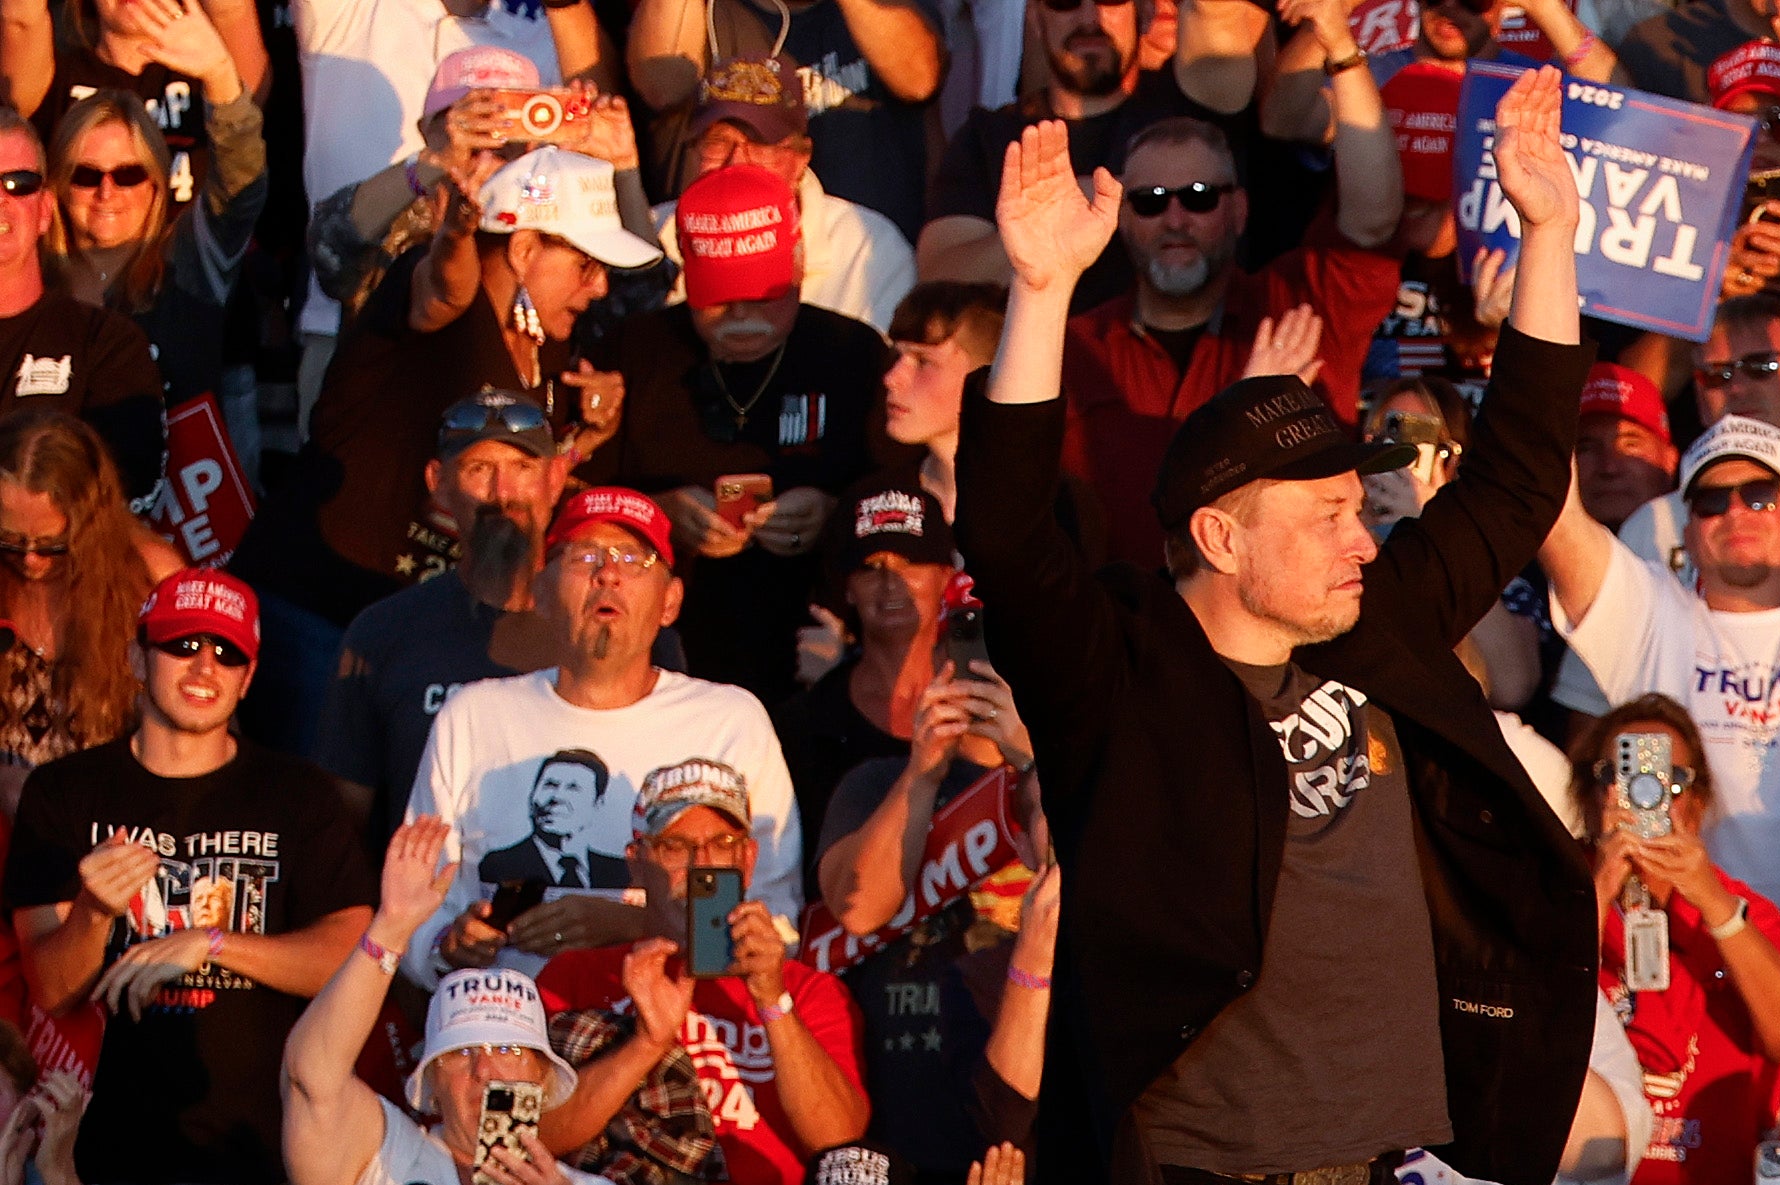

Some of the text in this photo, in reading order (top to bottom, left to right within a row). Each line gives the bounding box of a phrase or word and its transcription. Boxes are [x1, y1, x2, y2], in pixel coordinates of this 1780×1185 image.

[1566, 83, 1626, 110] 2024
[1580, 134, 1673, 174] AMERICA
[1674, 158, 1709, 183] MAKE
[684, 205, 783, 235] MAKE AMERICA
[735, 229, 778, 255] AGAIN
[1244, 389, 1303, 429] MAKE
[407, 521, 449, 553] TAKE
[90, 822, 279, 858] I WAS THERE
[446, 976, 537, 1002] TRUMP
[468, 994, 522, 1010] VANCE
[1452, 997, 1515, 1019] TOM FORD
